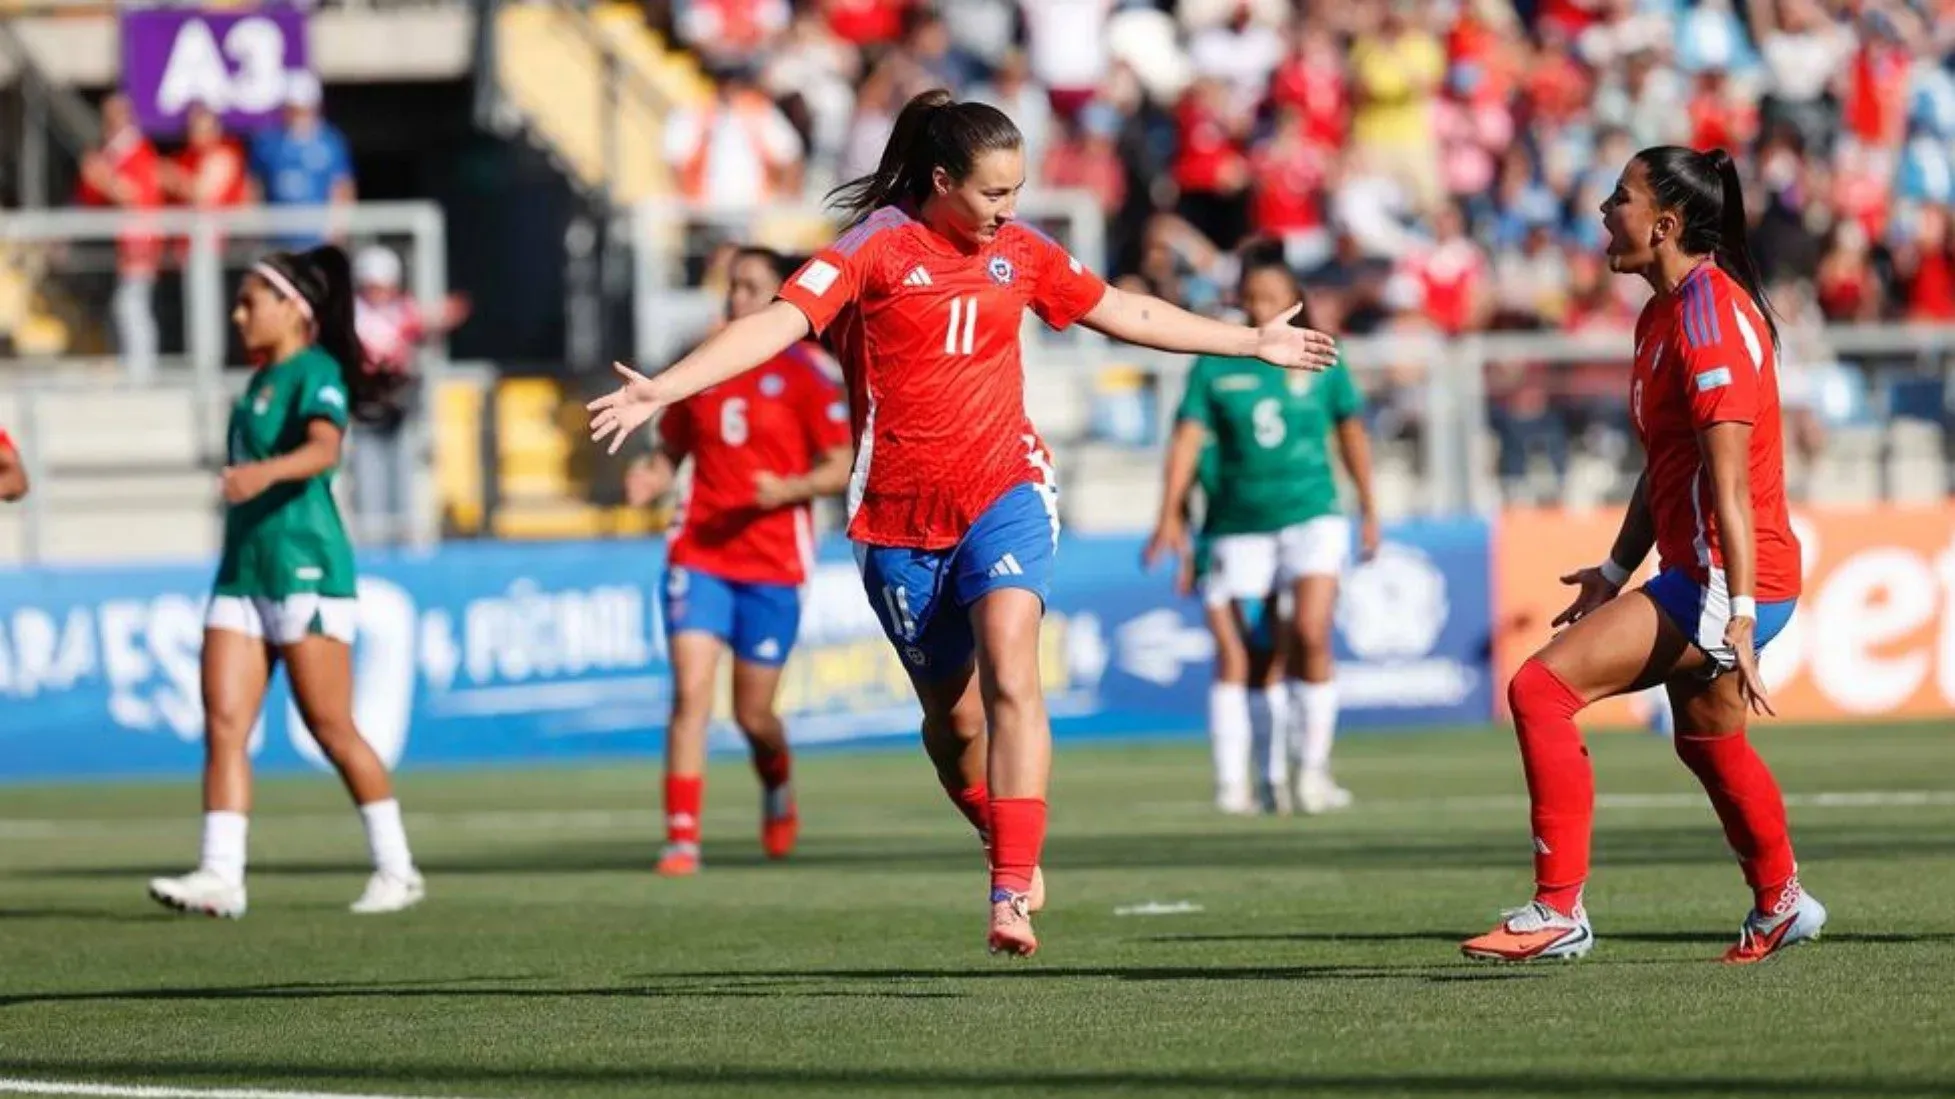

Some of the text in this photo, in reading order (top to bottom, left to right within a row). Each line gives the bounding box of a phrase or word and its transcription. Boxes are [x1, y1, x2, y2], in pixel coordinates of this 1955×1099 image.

[156, 17, 286, 116] A3
[945, 296, 978, 355] 11
[721, 396, 749, 448] 6
[881, 583, 916, 642] 11
